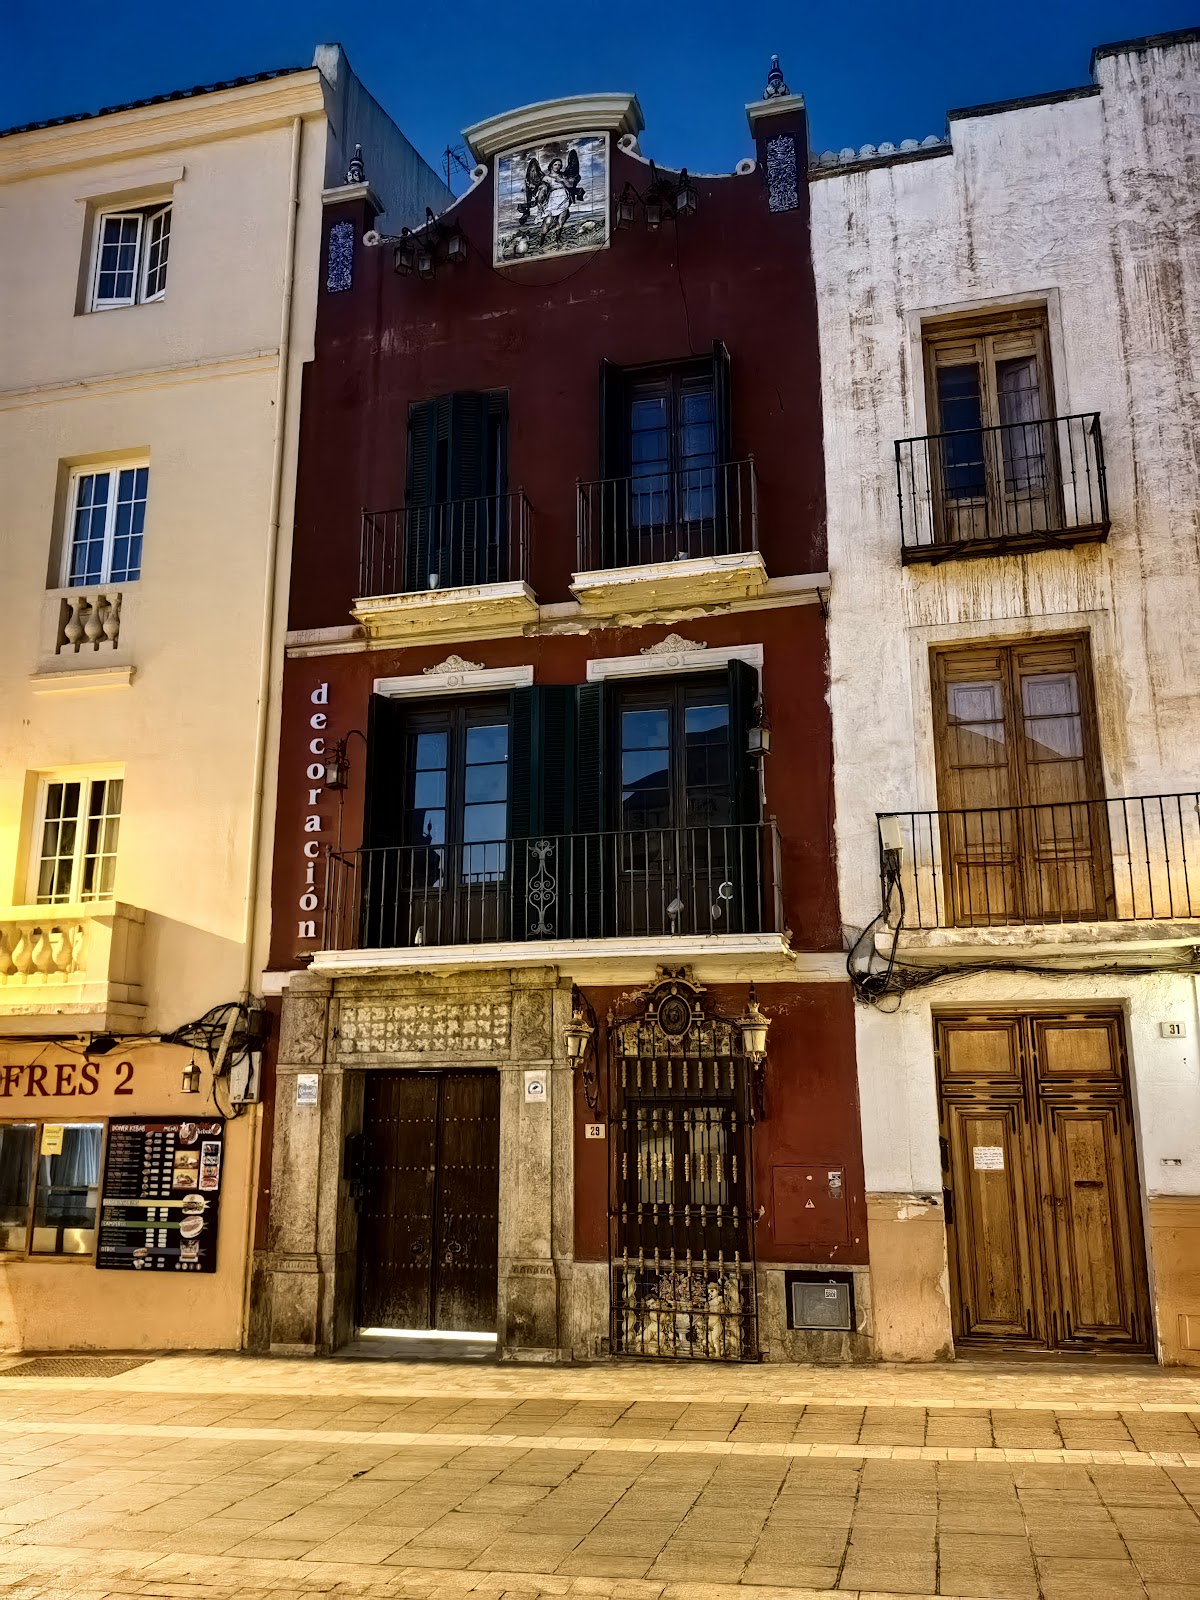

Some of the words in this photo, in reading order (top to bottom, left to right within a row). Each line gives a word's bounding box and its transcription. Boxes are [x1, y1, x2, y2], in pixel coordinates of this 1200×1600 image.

[298, 683, 329, 938] decoración
[1169, 1024, 1180, 1035] 31
[0, 1062, 100, 1097] FRES
[114, 1061, 134, 1096] 2
[590, 1126, 600, 1136] 29
